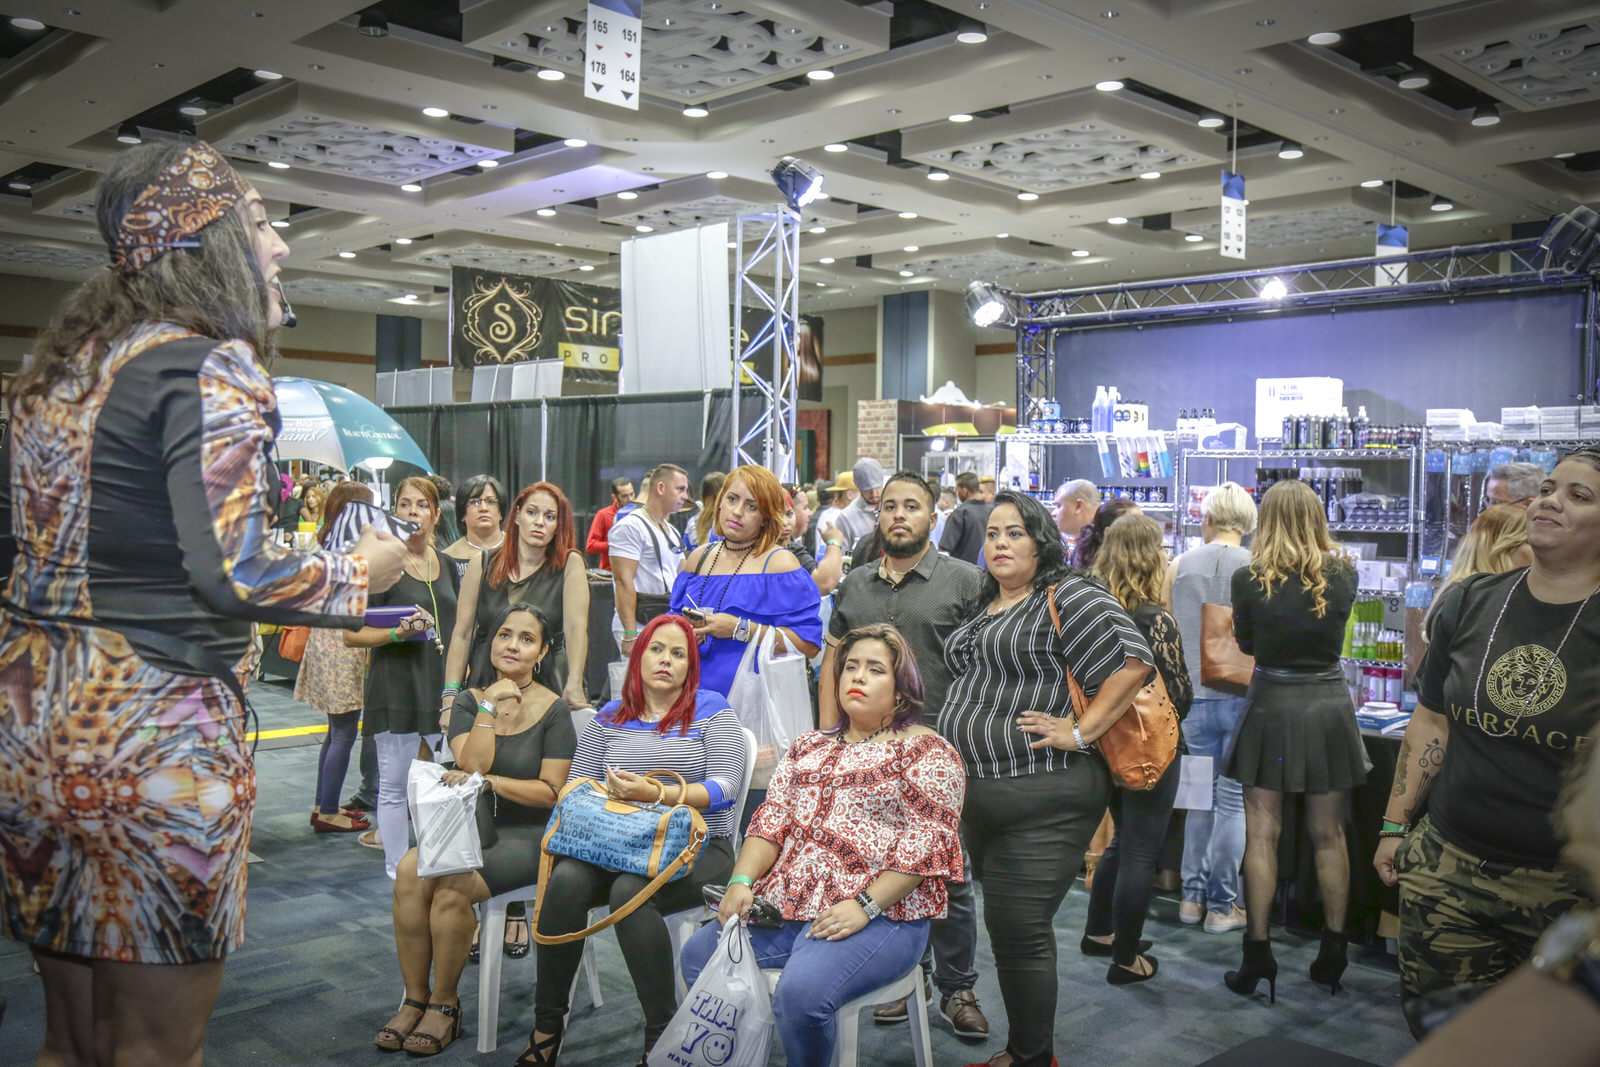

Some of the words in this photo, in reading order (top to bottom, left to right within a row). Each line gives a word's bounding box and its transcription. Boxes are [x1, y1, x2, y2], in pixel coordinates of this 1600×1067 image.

[592, 19, 608, 34] 165
[622, 28, 637, 43] 151
[591, 60, 606, 75] 178
[620, 68, 635, 83] 164
[565, 297, 622, 336] sin
[564, 350, 608, 364] PRO
[1450, 703, 1591, 752] VERSACE
[567, 846, 601, 862] NEW
[690, 989, 737, 1032] THA
